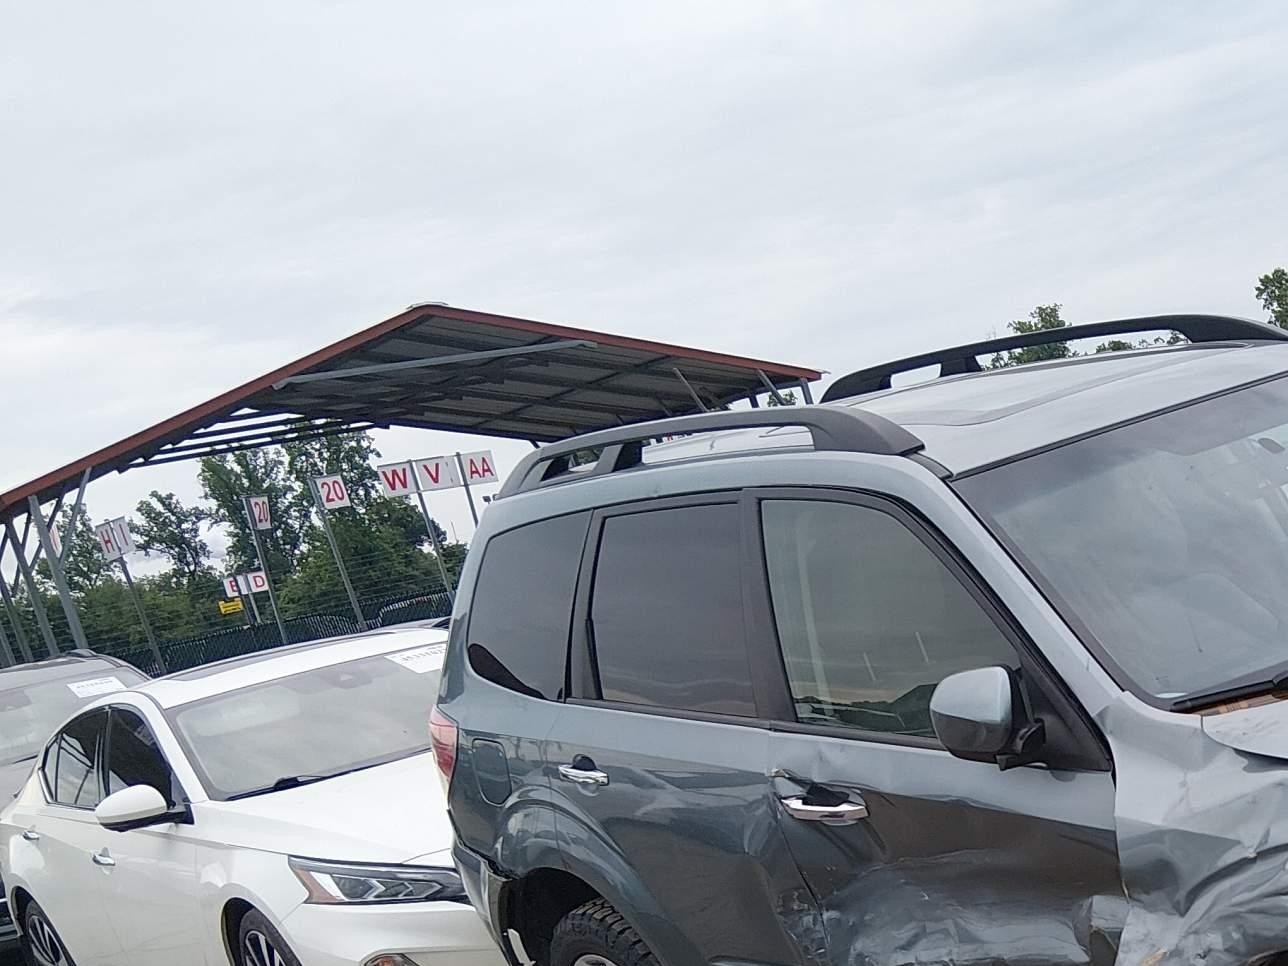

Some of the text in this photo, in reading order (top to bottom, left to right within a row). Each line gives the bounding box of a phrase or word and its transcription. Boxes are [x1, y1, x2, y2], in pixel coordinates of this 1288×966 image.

[381, 467, 408, 491] W
[422, 462, 440, 484] V
[469, 456, 494, 479] AA
[321, 480, 345, 503] 20
[254, 500, 269, 523] 20
[100, 528, 115, 554] H
[252, 575, 265, 588] D
